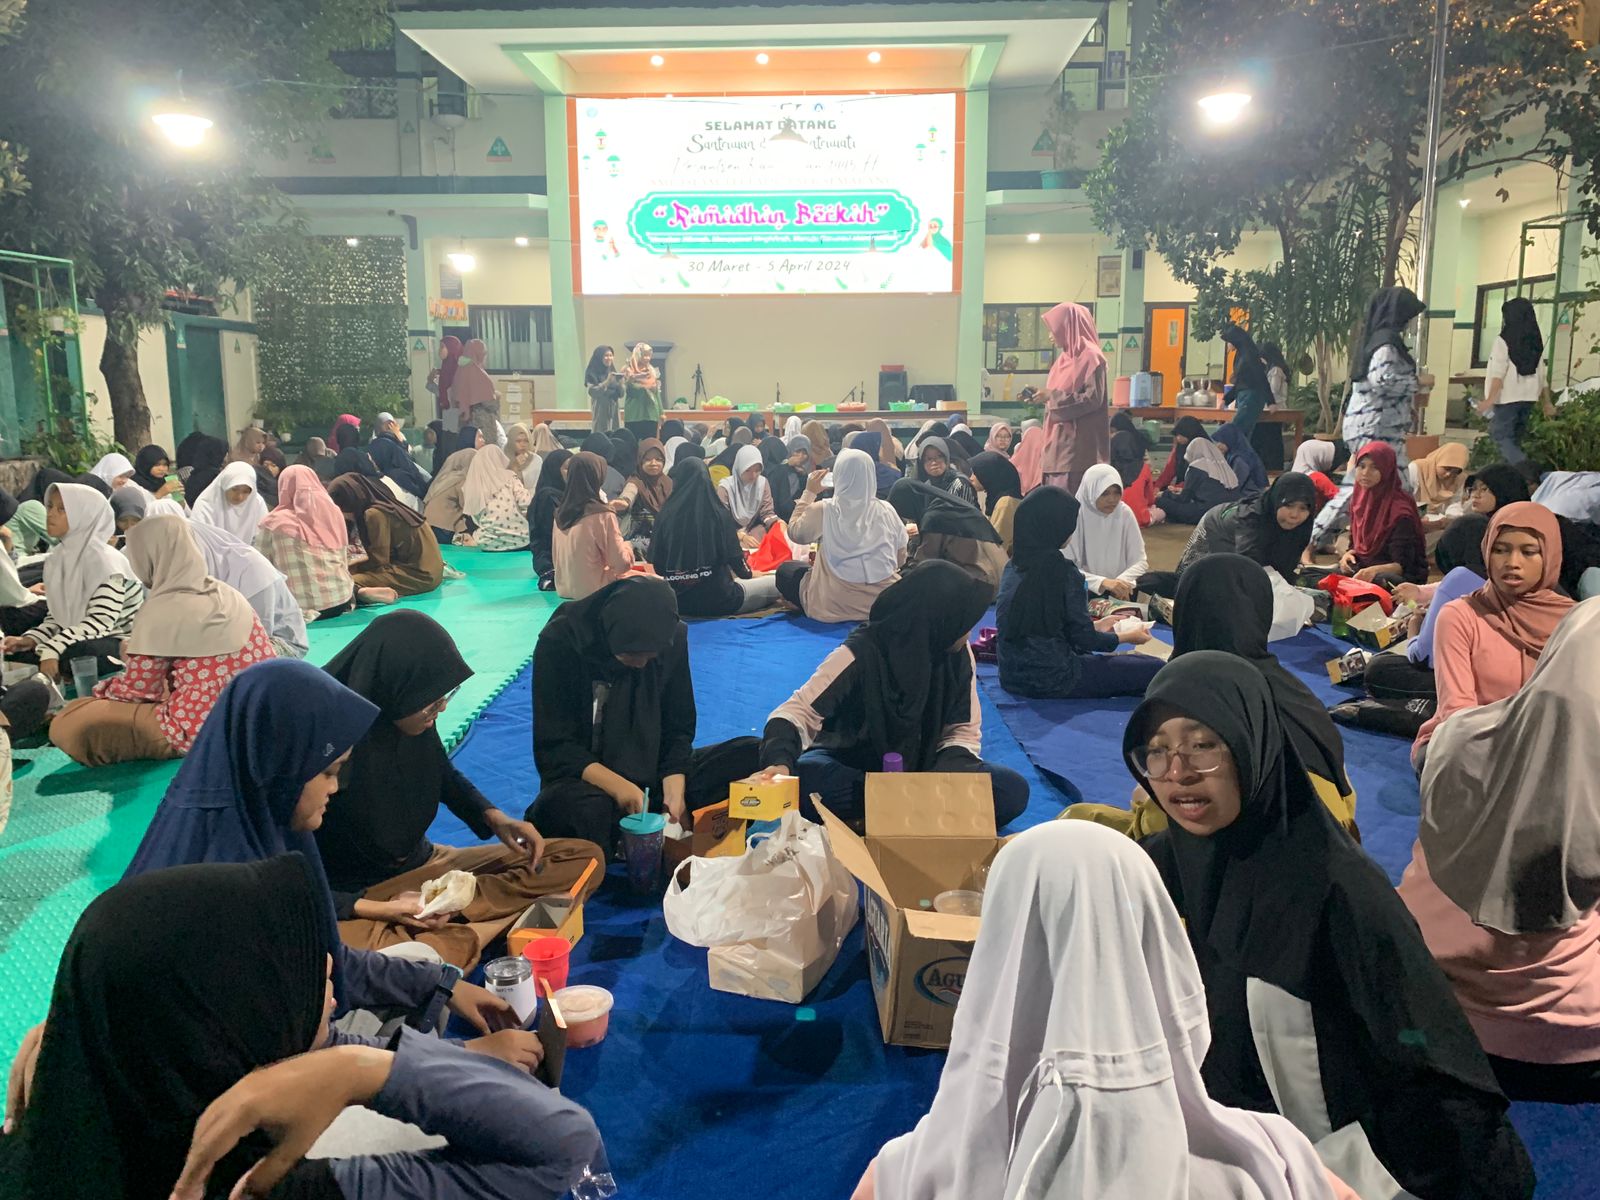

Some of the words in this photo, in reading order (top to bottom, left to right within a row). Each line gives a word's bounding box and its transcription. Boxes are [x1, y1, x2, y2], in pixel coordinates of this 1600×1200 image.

[705, 120, 773, 131] SELAMAT
[778, 119, 837, 130] DATANG
[688, 261, 704, 272] 30
[708, 259, 750, 272] Maret
[768, 260, 775, 272] 5
[779, 258, 813, 274] April
[816, 260, 851, 271] 2024
[927, 967, 967, 987] AGU
